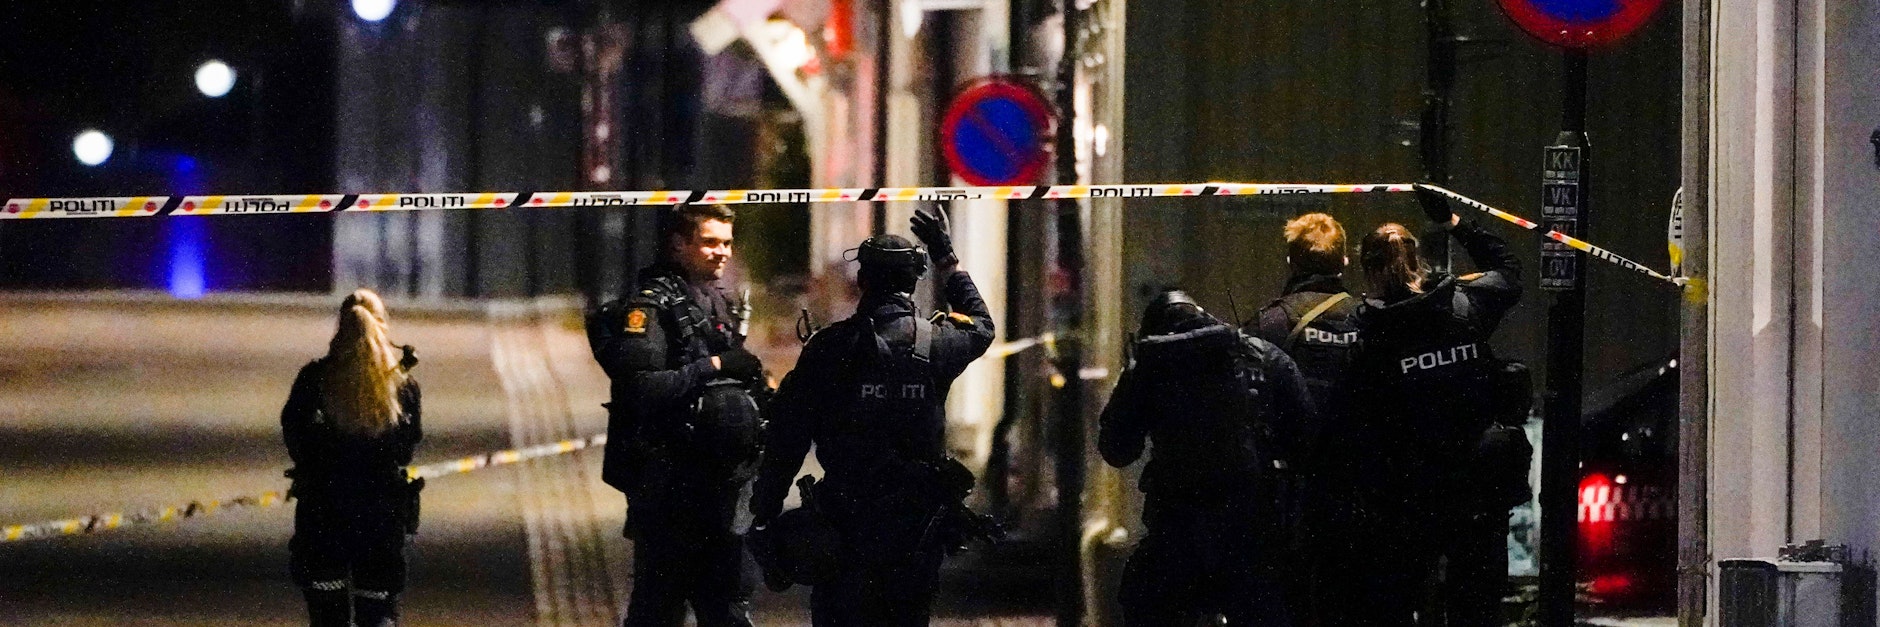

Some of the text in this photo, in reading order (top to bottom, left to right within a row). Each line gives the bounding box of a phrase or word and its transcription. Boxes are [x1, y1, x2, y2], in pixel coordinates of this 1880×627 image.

[1552, 151, 1574, 170] KK
[400, 196, 464, 208] POLITI
[1551, 187, 1571, 205] VK
[50, 199, 115, 213] POLITI
[225, 201, 290, 213] POLITI
[1304, 327, 1358, 345] POLIT
[1400, 343, 1478, 374] POLITI
[861, 383, 925, 400] POITI
